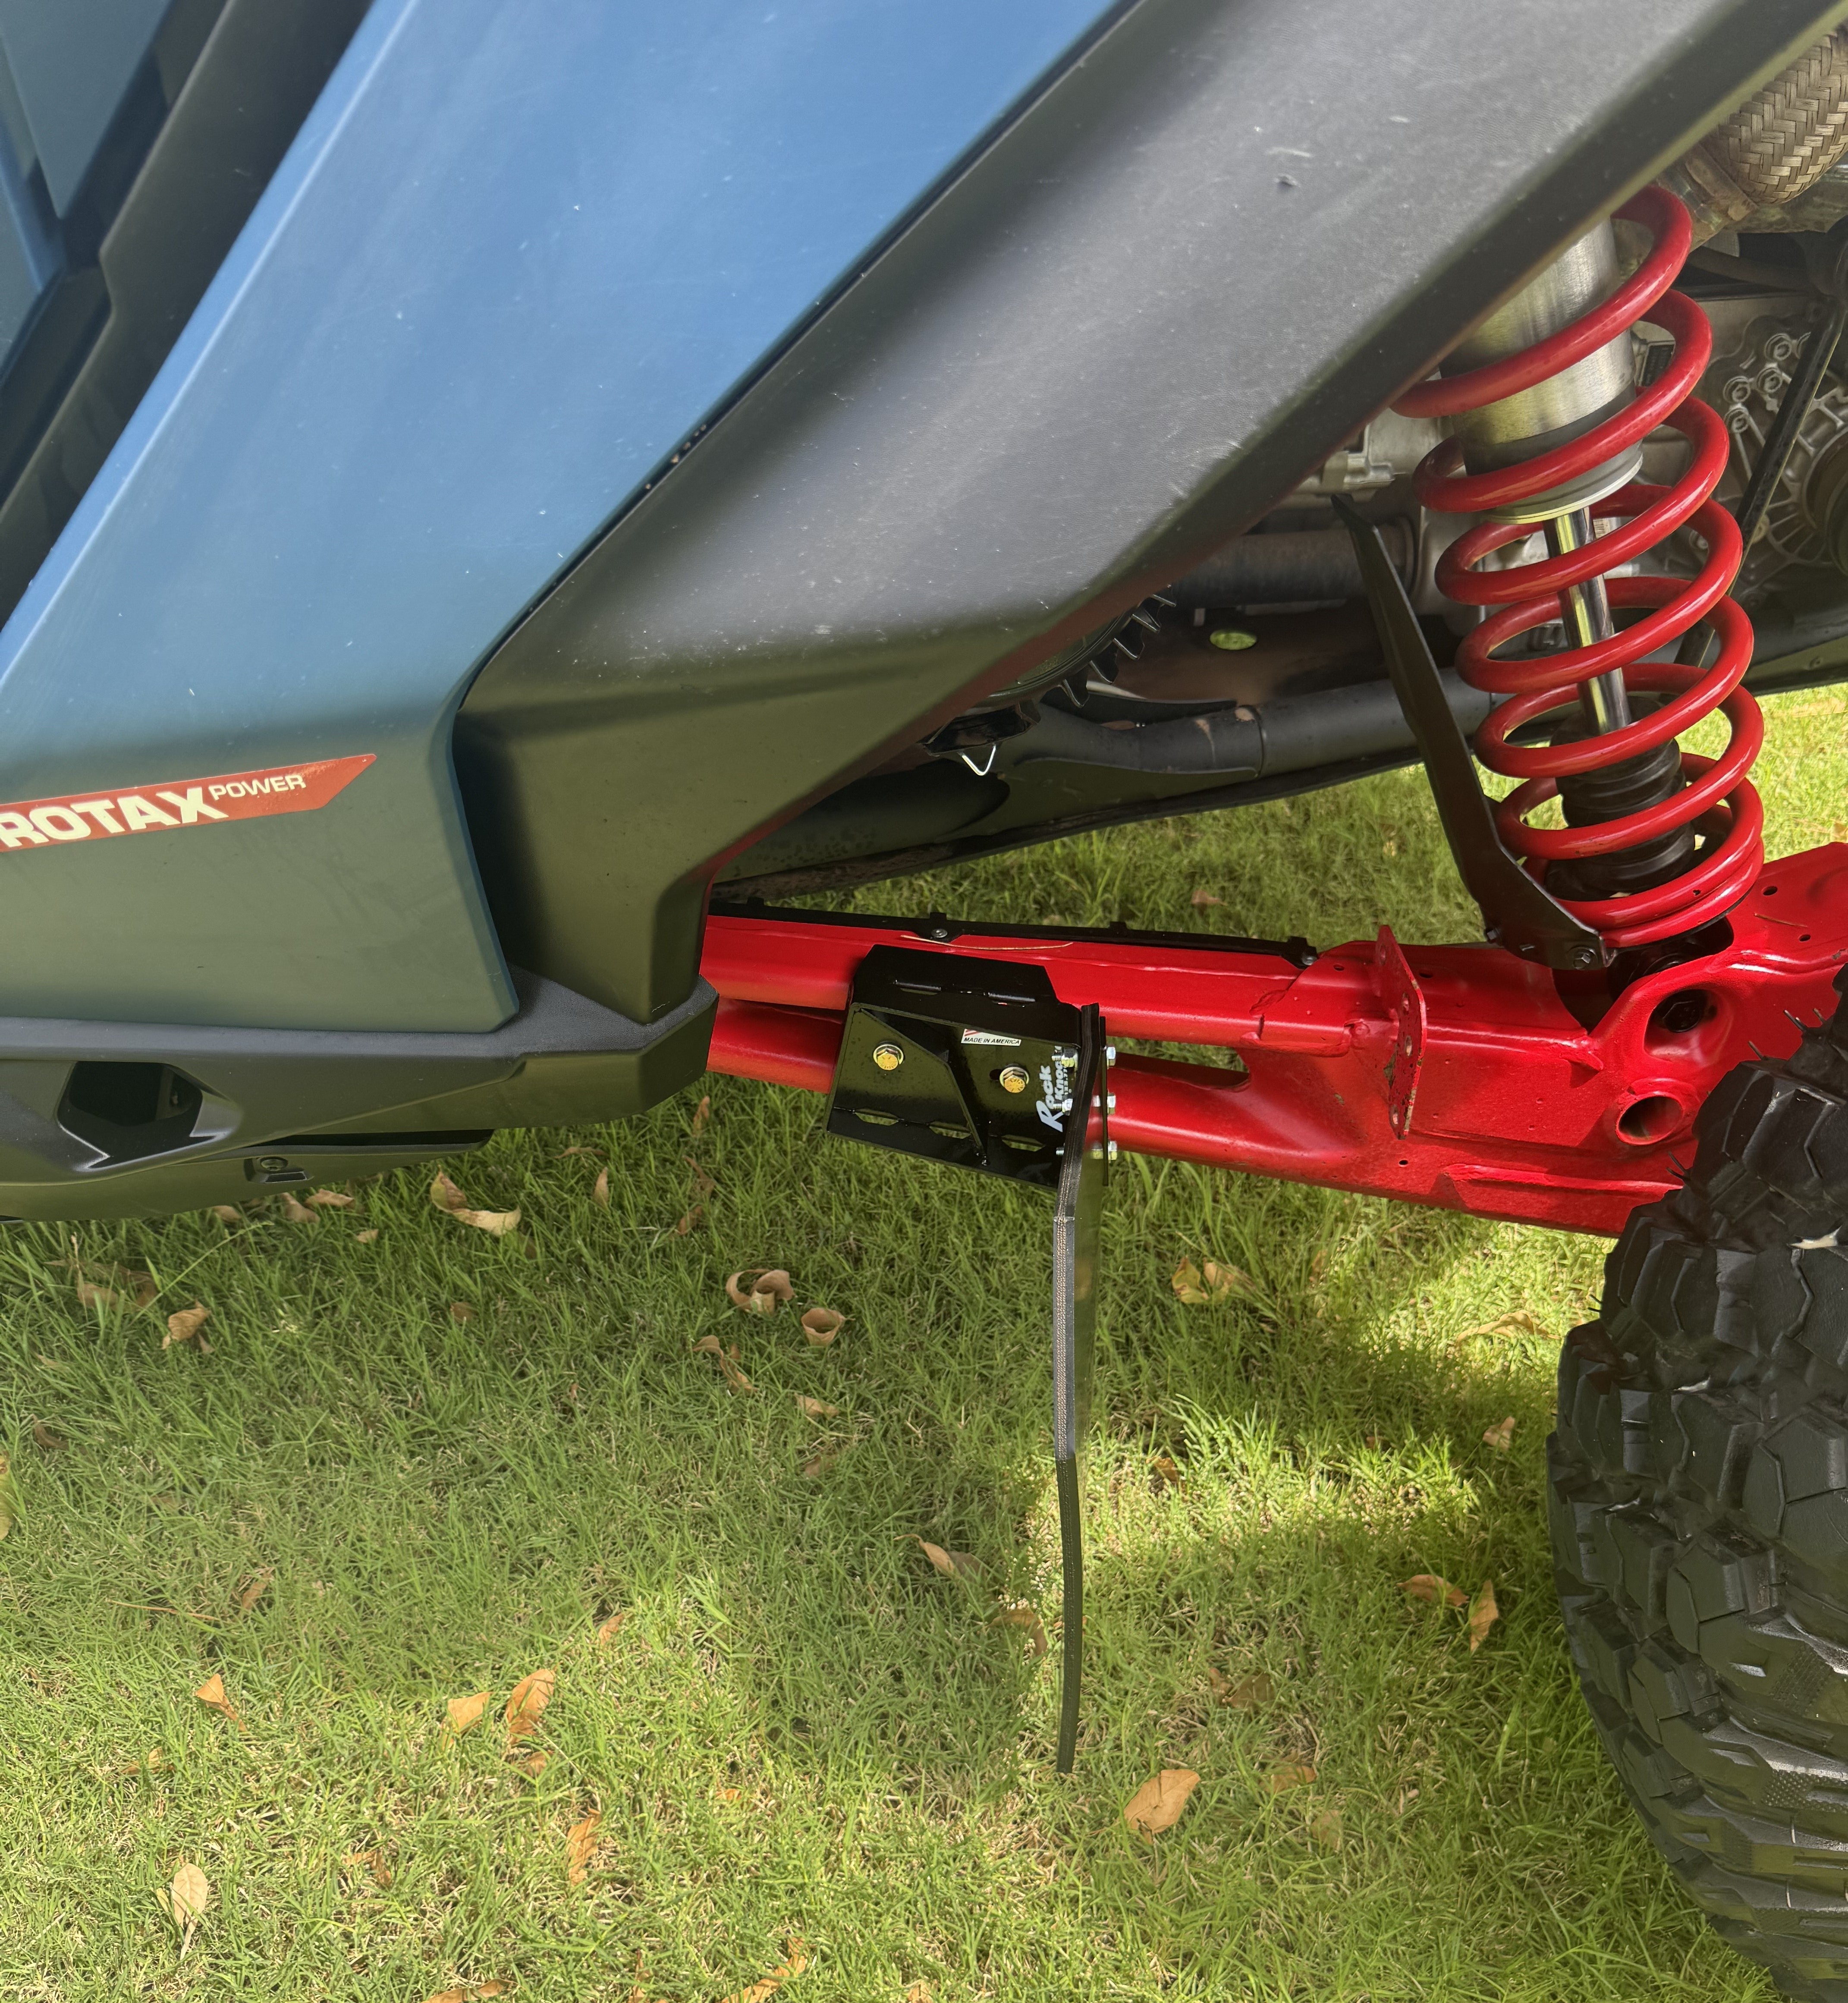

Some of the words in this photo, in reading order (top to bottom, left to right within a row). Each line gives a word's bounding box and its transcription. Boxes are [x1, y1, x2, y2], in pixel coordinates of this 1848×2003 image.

[0, 787, 229, 848] ROTAX
[208, 774, 306, 801] POWER
[1036, 1065, 1065, 1132] Rock
